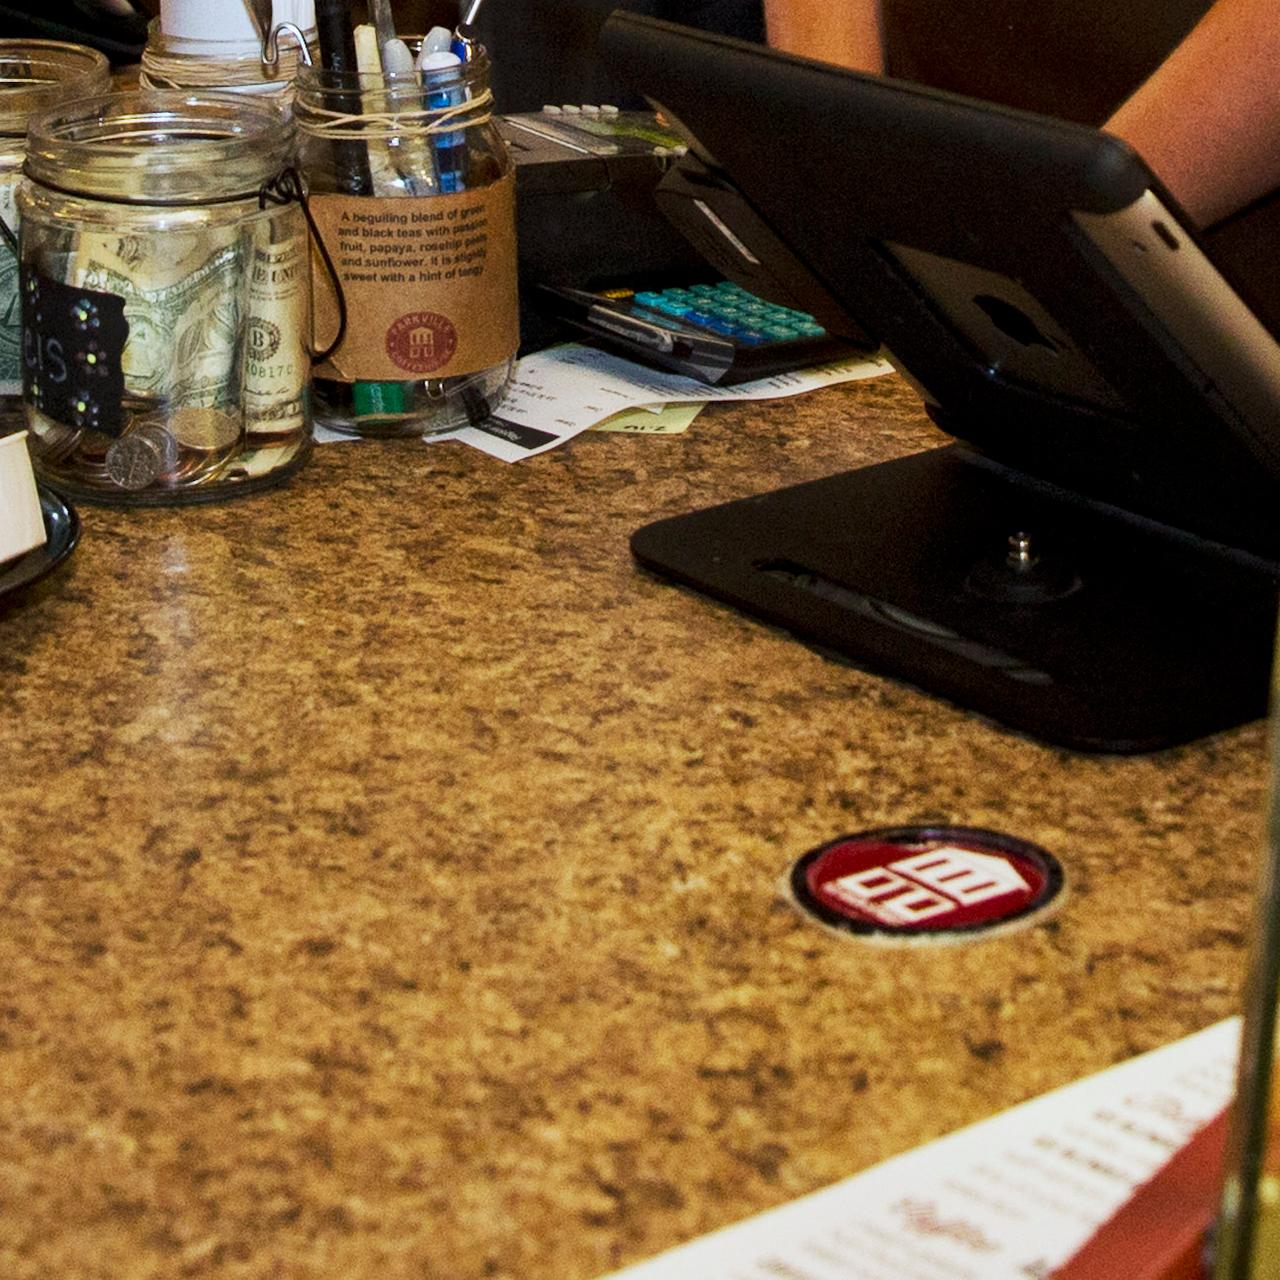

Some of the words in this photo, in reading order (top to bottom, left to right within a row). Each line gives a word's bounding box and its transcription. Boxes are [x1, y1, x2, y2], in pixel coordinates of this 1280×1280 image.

[341, 211, 350, 221] A
[411, 211, 443, 223] blend
[447, 208, 458, 220] of
[338, 227, 359, 237] and
[362, 227, 393, 238] black
[397, 228, 422, 238] teas
[426, 225, 450, 238] with
[341, 257, 362, 267] and
[343, 272, 378, 283] sweet
[380, 272, 405, 283] with
[419, 270, 441, 282] hint
[445, 268, 456, 279] of
